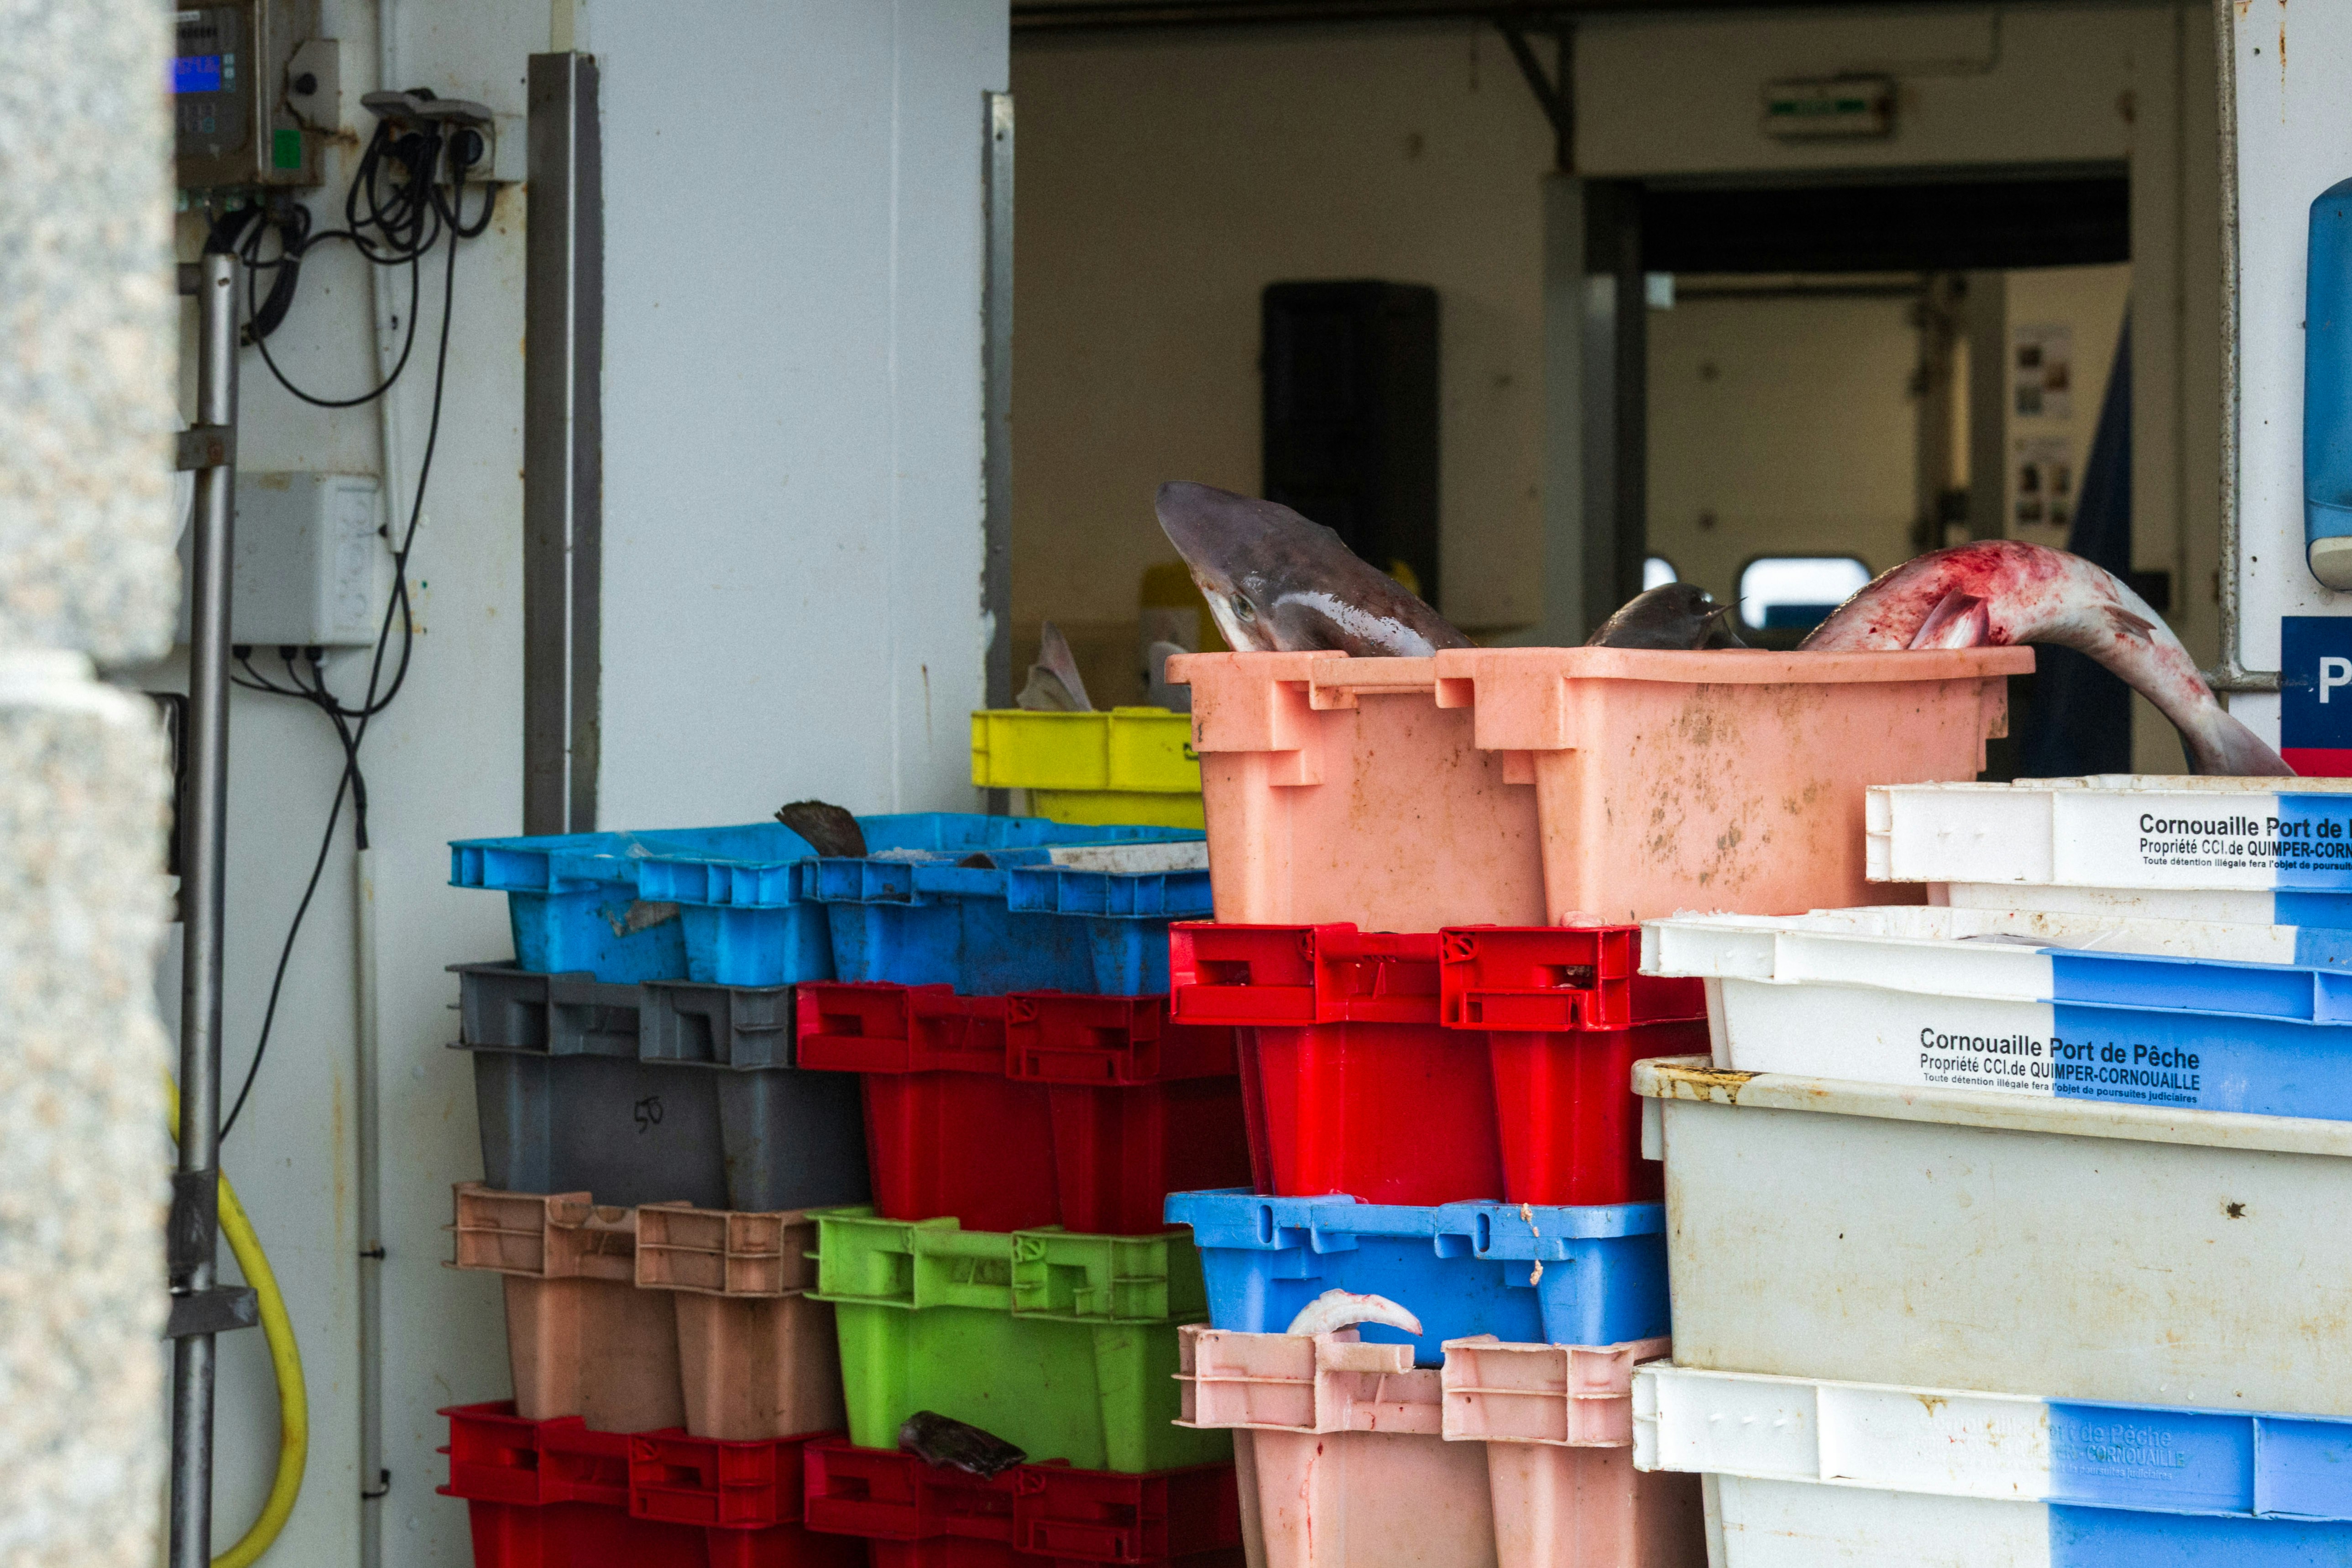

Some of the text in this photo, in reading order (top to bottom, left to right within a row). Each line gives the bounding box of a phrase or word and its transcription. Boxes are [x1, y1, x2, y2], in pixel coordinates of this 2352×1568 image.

[2140, 814, 2259, 836] Cornouaille
[2266, 817, 2310, 838] Port
[2316, 818, 2342, 838] de
[2140, 838, 2197, 857] Propriété
[2202, 839, 2243, 856] CCI.de
[2143, 857, 2352, 871] Toute détention illégale fera l'objet de poursuit
[1920, 1027, 2200, 1070] Cornouaille Port de Pêche
[1920, 1053, 2200, 1091] Propriété CCI.de QUIMPER-CORNOUAILLE
[1923, 1072, 2197, 1103] Toute détention illégale fera l'objet de poursuites judiciaires
[634, 1096, 663, 1134] 50
[2080, 1422, 2103, 1443] de
